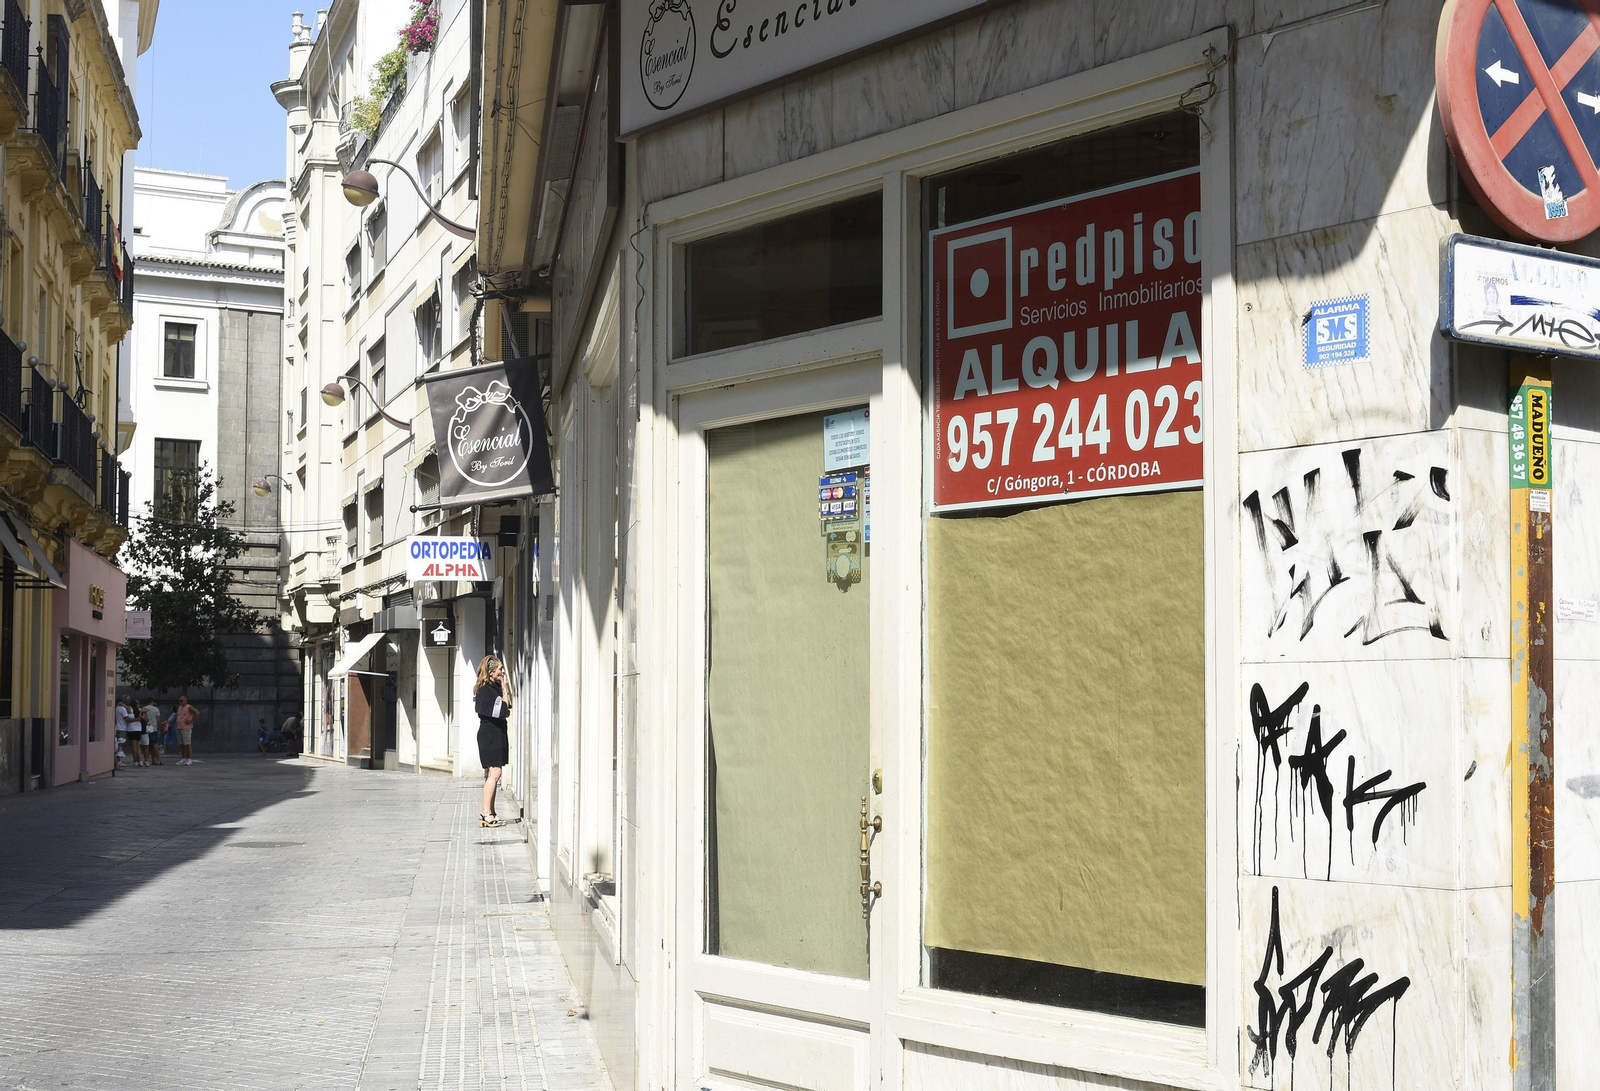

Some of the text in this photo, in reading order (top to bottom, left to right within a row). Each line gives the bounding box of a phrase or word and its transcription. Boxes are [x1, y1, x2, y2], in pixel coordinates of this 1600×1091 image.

[644, 26, 690, 80] Esencial
[653, 81, 665, 95] By
[1020, 211, 1202, 298] redpiso
[1020, 276, 1203, 326] Servicios Inmobiliarios
[1313, 302, 1360, 316] ALARMA
[1317, 313, 1357, 345] SMS
[1317, 341, 1357, 353] SEGURIDAD
[953, 310, 1202, 400] ALQUILA
[453, 418, 523, 459] Esencial
[947, 380, 1203, 473] 957 244 023
[1510, 394, 1526, 480] 957 48 36 37
[1531, 394, 1547, 481] MADUEÑO
[470, 460, 487, 473] By
[987, 476, 1001, 496] C/
[1004, 472, 1064, 494] Góngora,
[1067, 469, 1075, 485] 1
[1086, 459, 1161, 484] CÓRDOBA
[410, 540, 492, 560] ORTOPEDIA
[422, 563, 479, 577] ALPHA
